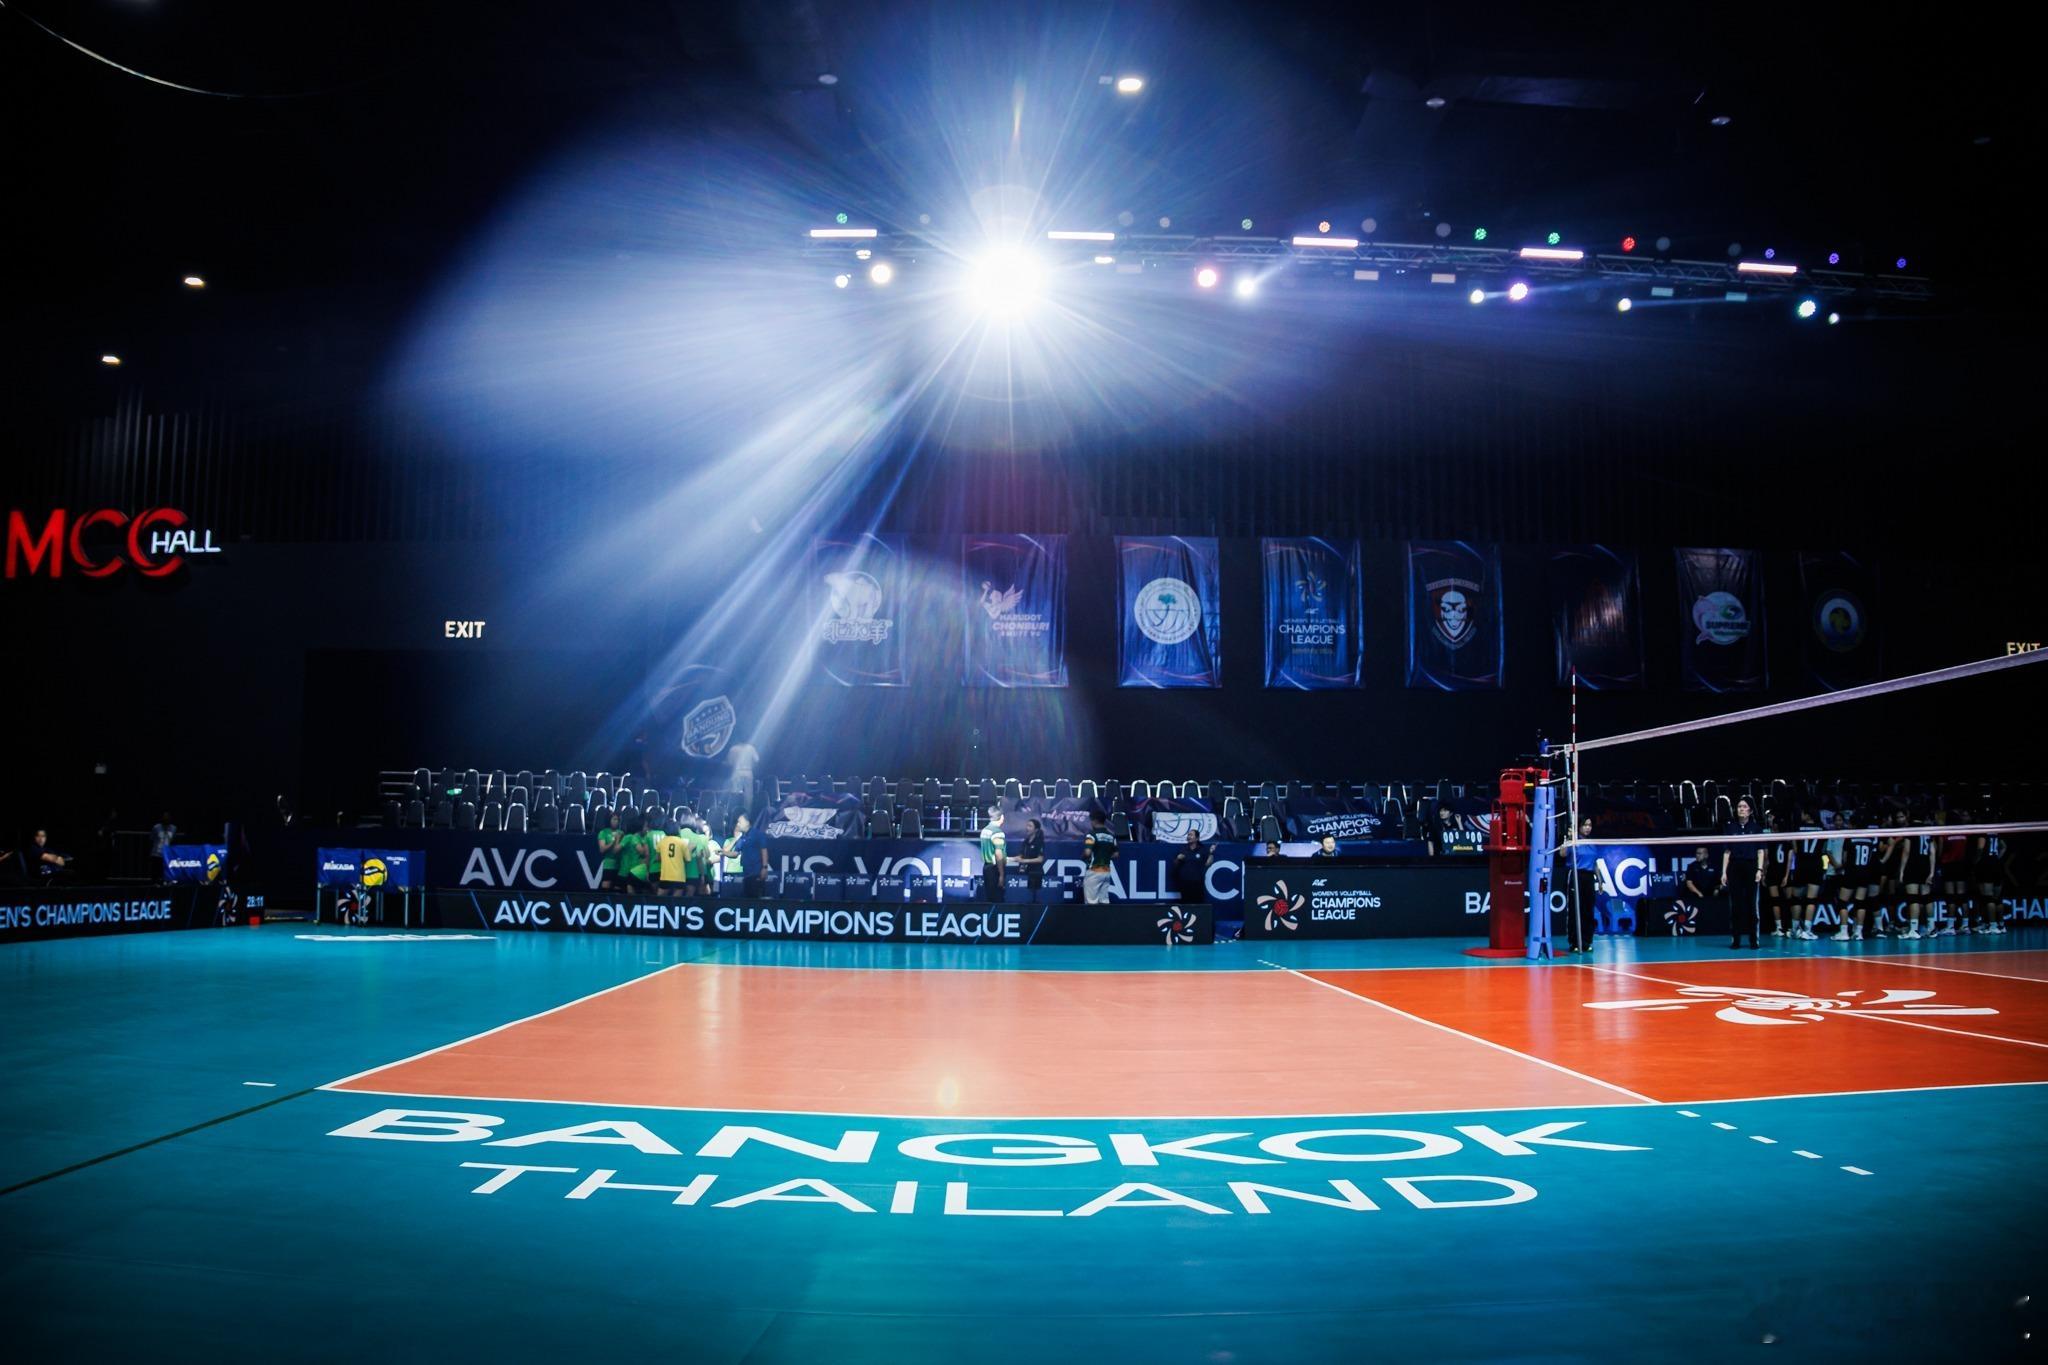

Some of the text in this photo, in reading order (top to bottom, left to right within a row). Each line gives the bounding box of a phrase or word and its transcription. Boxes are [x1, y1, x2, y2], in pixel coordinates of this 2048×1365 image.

[5, 508, 189, 579] MCC
[151, 529, 221, 555] HALL
[445, 621, 485, 639] EXIT
[992, 622, 1050, 631] CHONBURI
[1279, 624, 1346, 634] CHAMPIONS
[1291, 635, 1334, 644] LEAGUE
[2006, 641, 2041, 656] EXIT
[1307, 817, 1382, 834] CHAMPIONS
[1323, 826, 1372, 838] EAGUE
[668, 843, 675, 858] 9
[1776, 843, 1785, 863] 6
[1855, 845, 1869, 866] 18
[459, 847, 558, 888] AVC
[1311, 897, 1381, 908] CHAMPIONS
[36, 902, 121, 926] CHAMPIONS
[125, 901, 171, 921] LEAGUE
[494, 900, 1020, 938] AVC WOMEN'S CHAMPIONS LEAGUE
[1311, 909, 1356, 920] LEAGUE
[325, 1108, 1654, 1167] BANGKOK
[459, 1161, 1538, 1216] THAILAND
